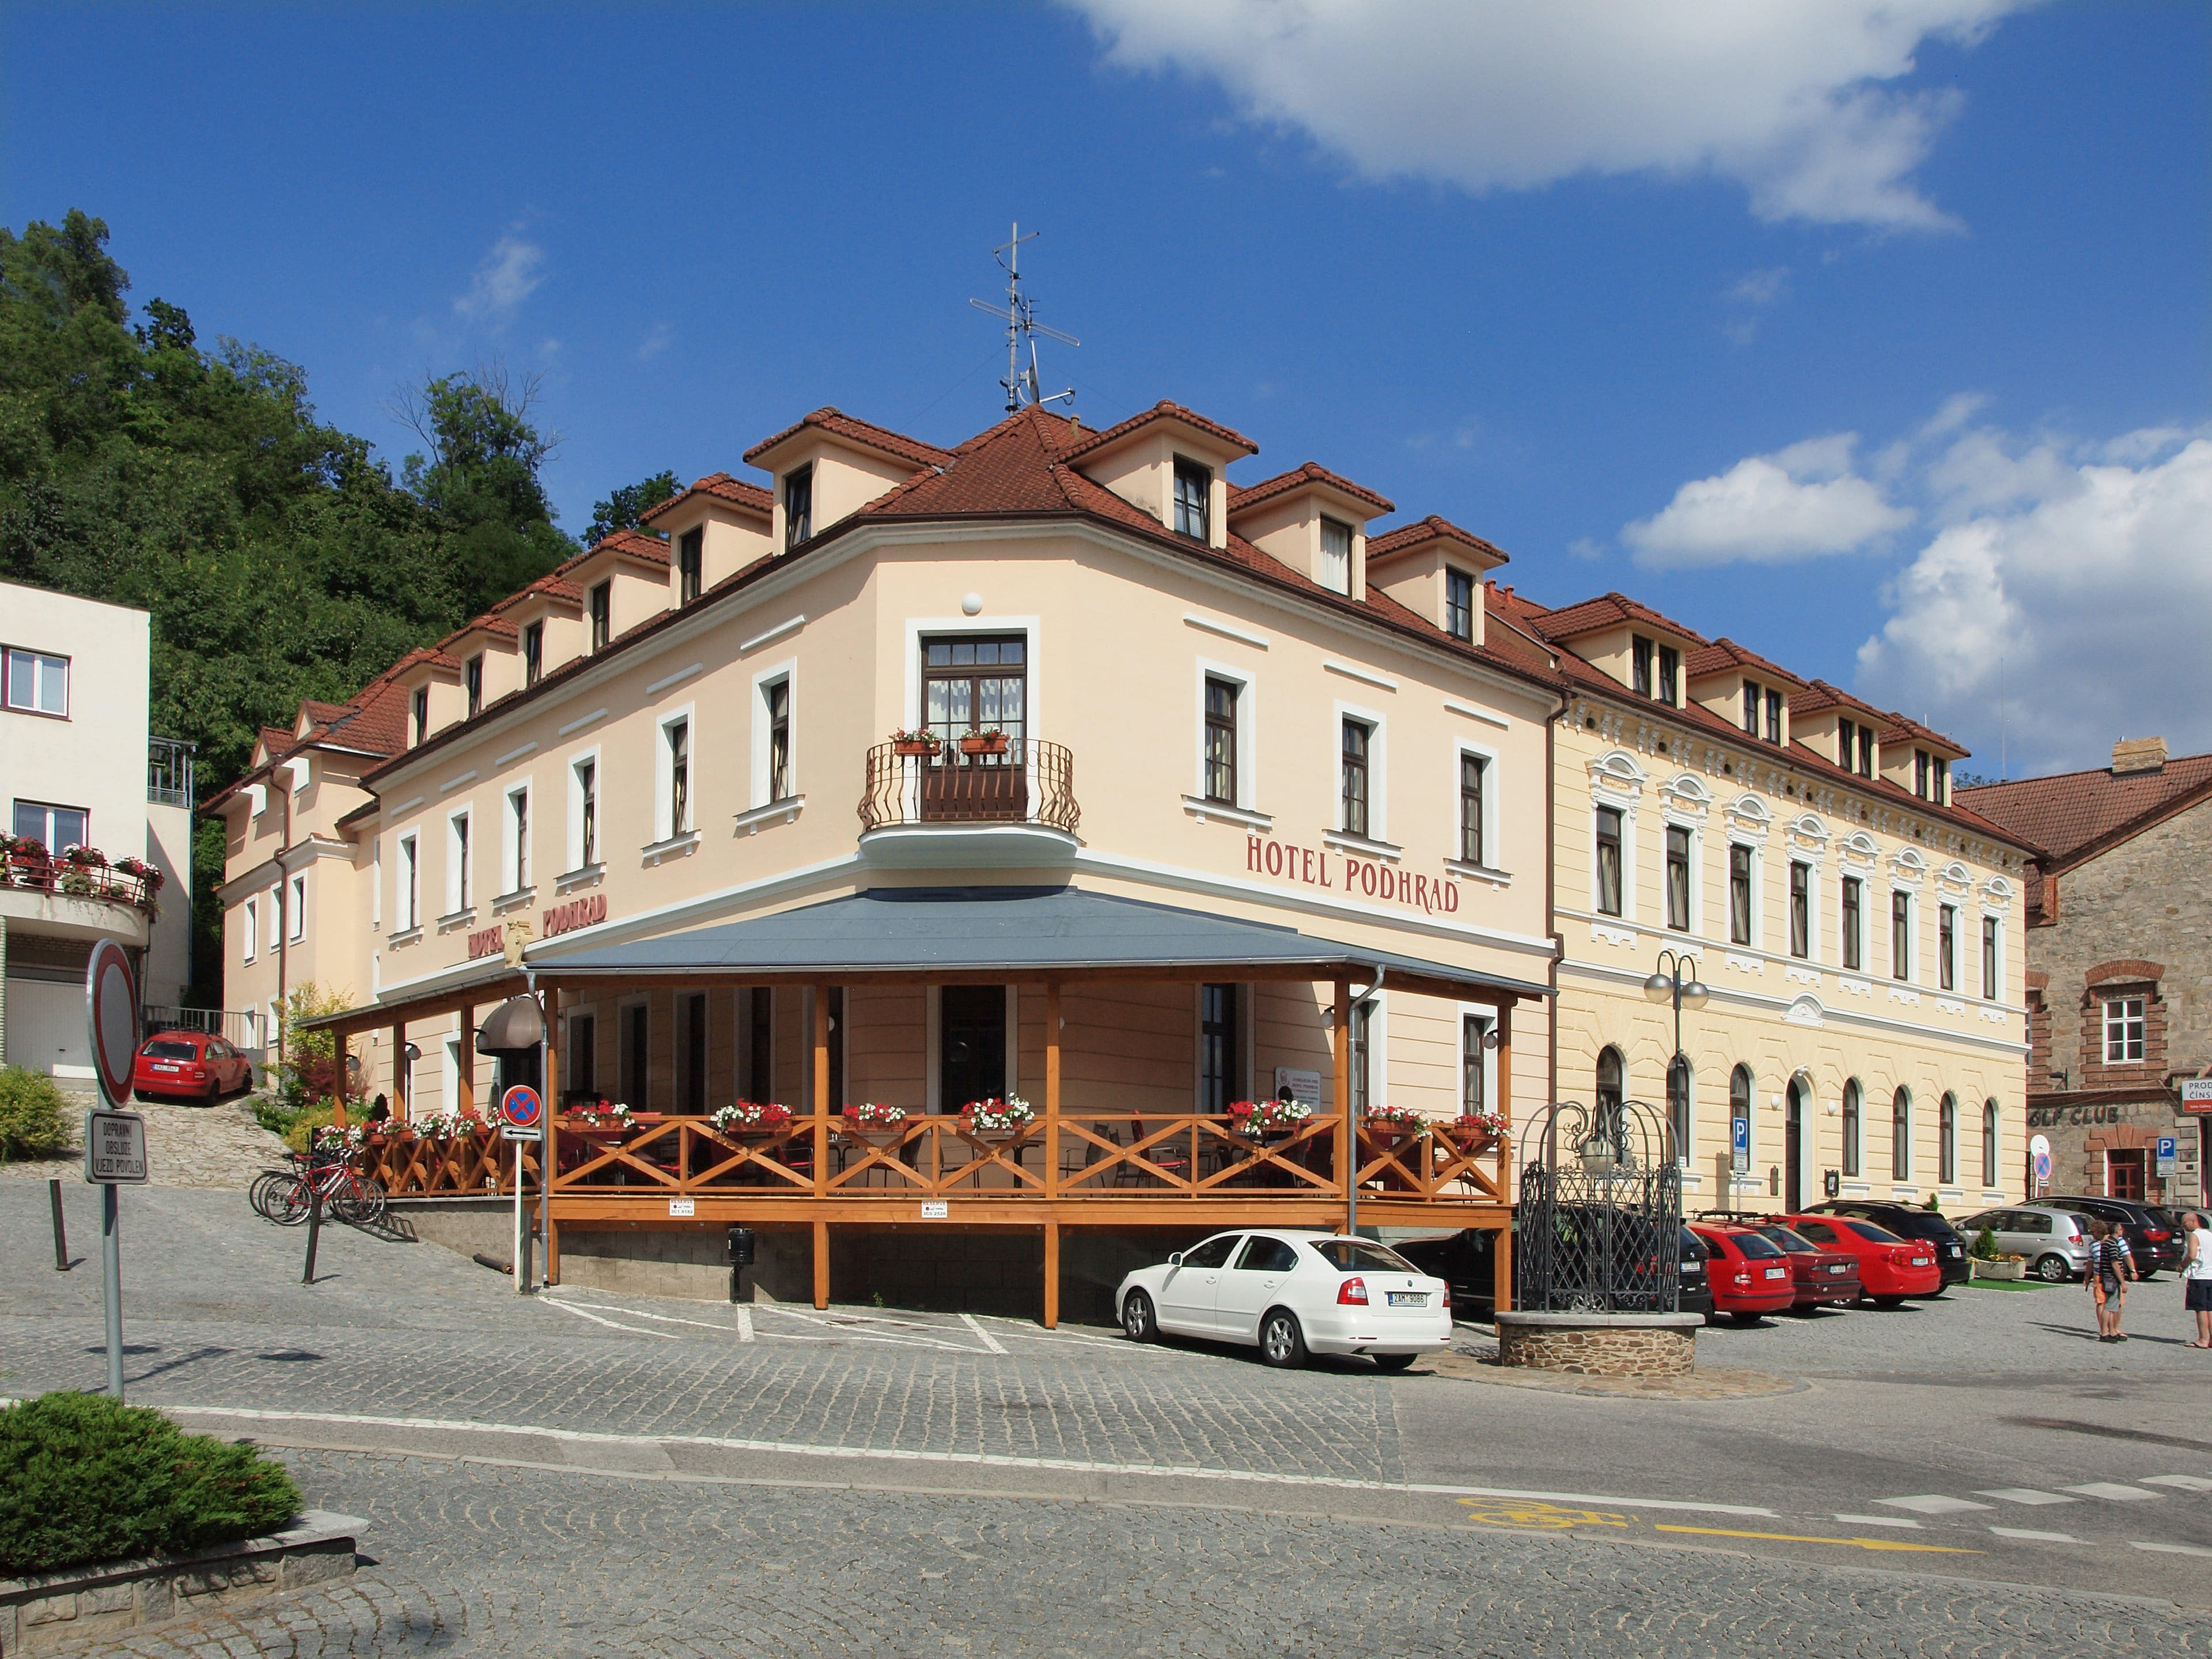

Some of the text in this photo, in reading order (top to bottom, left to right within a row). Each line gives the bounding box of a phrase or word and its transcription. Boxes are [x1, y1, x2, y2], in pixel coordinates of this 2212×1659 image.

[1247, 835, 1459, 915] HOTEL PODHRAD
[468, 893, 608, 959] HOTEL PODHRAD
[2189, 1091, 2212, 1099] ČÍNS
[2070, 1106, 2119, 1126] CLUB
[103, 1121, 132, 1138] DOPRAVNÍ
[1736, 1122, 1745, 1142] P
[106, 1141, 132, 1156] OBSLUZE
[2161, 1140, 2172, 1154] P
[95, 1158, 143, 1174] VJEZD POVOLEN
